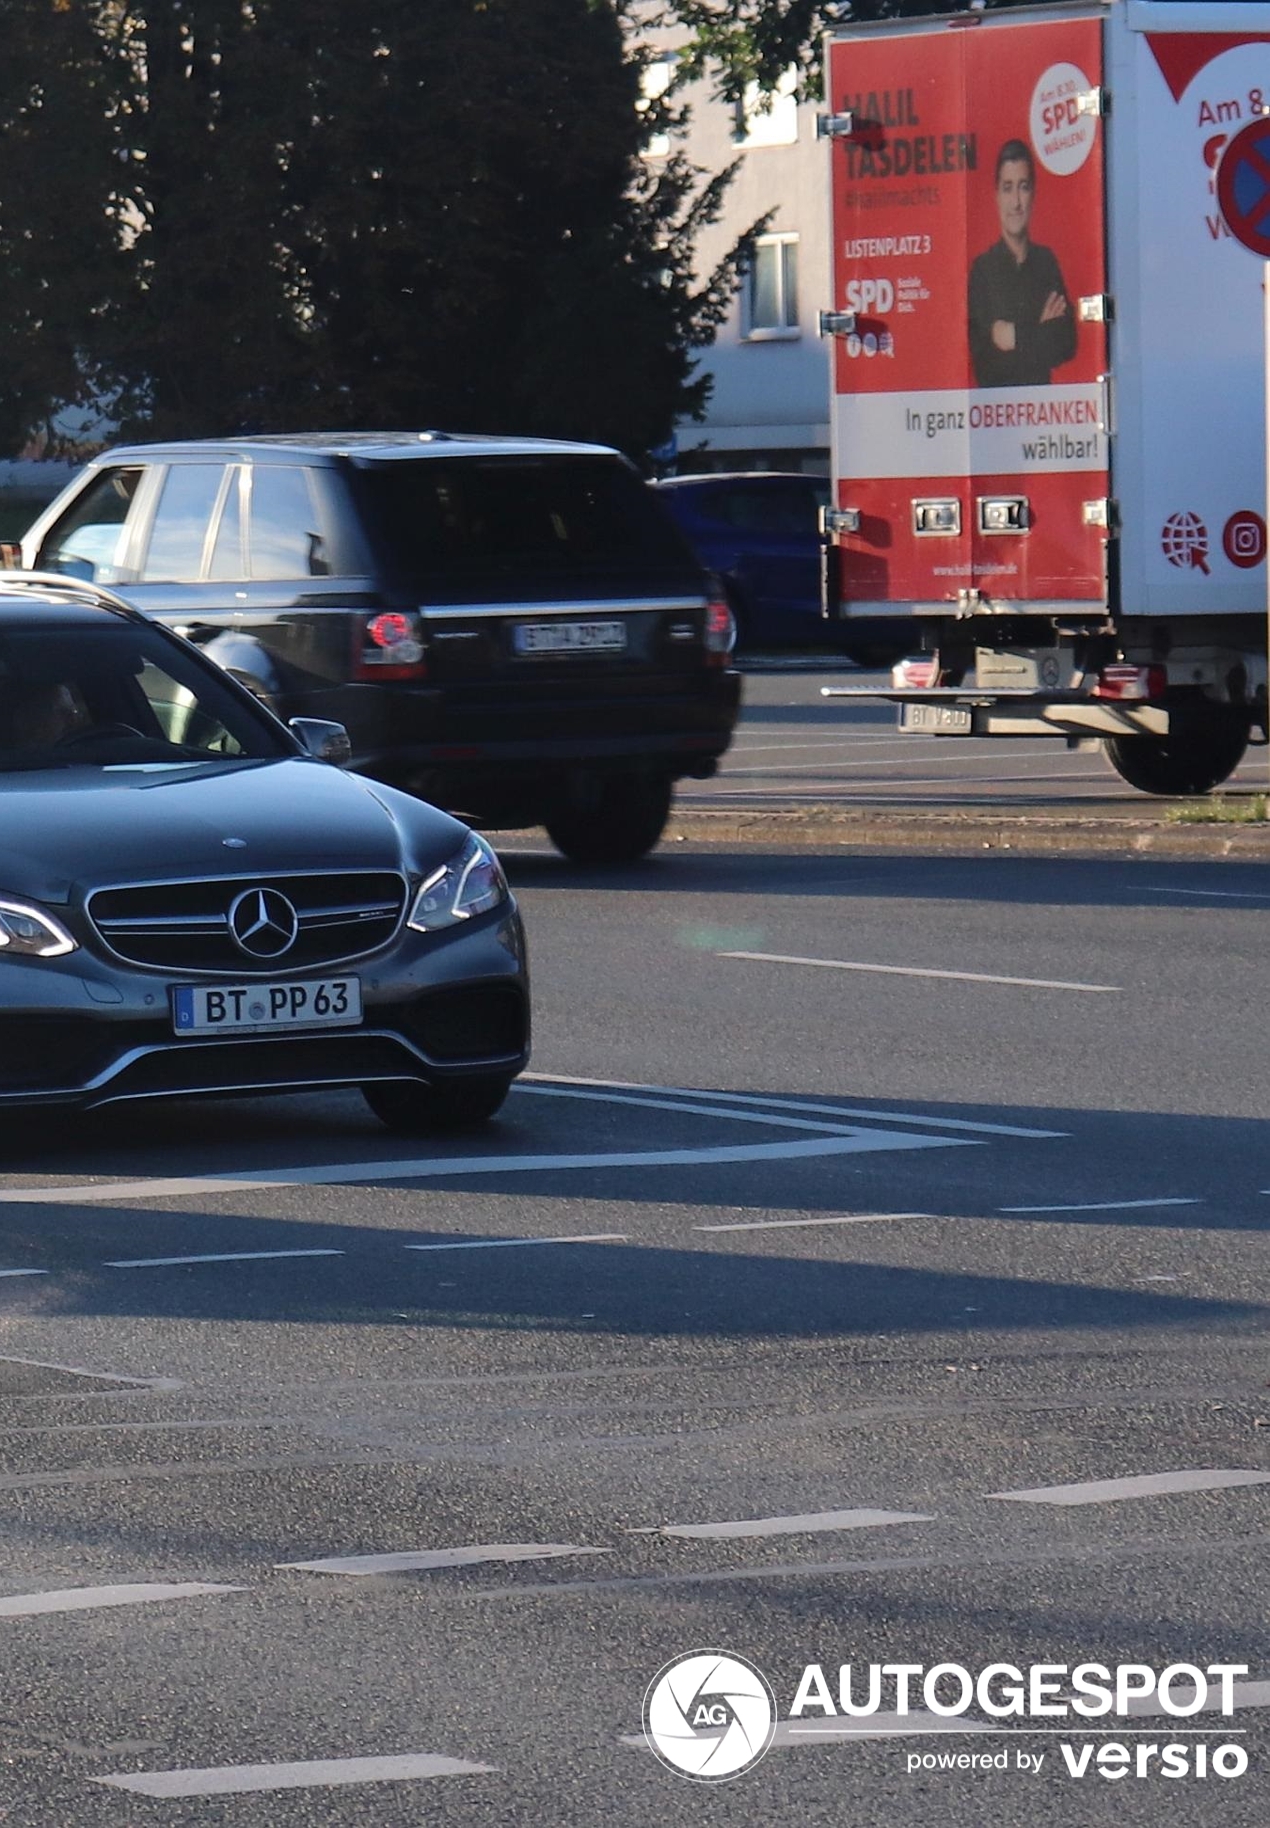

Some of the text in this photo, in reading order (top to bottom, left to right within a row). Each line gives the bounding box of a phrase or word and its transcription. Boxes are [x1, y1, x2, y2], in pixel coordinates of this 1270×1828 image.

[843, 88, 919, 127] HALIL
[1042, 98, 1080, 135] SPD
[1198, 100, 1241, 127] Am
[844, 132, 978, 180] TASDELEN
[845, 235, 932, 258] LISTENPLATZ 3
[845, 278, 894, 314] SPD
[906, 400, 1098, 438] In ganz OBERFRANKEN
[1023, 432, 1098, 460] wählbar!
[206, 989, 247, 1023] BT
[270, 986, 307, 1019] PP
[314, 983, 348, 1016] 63
